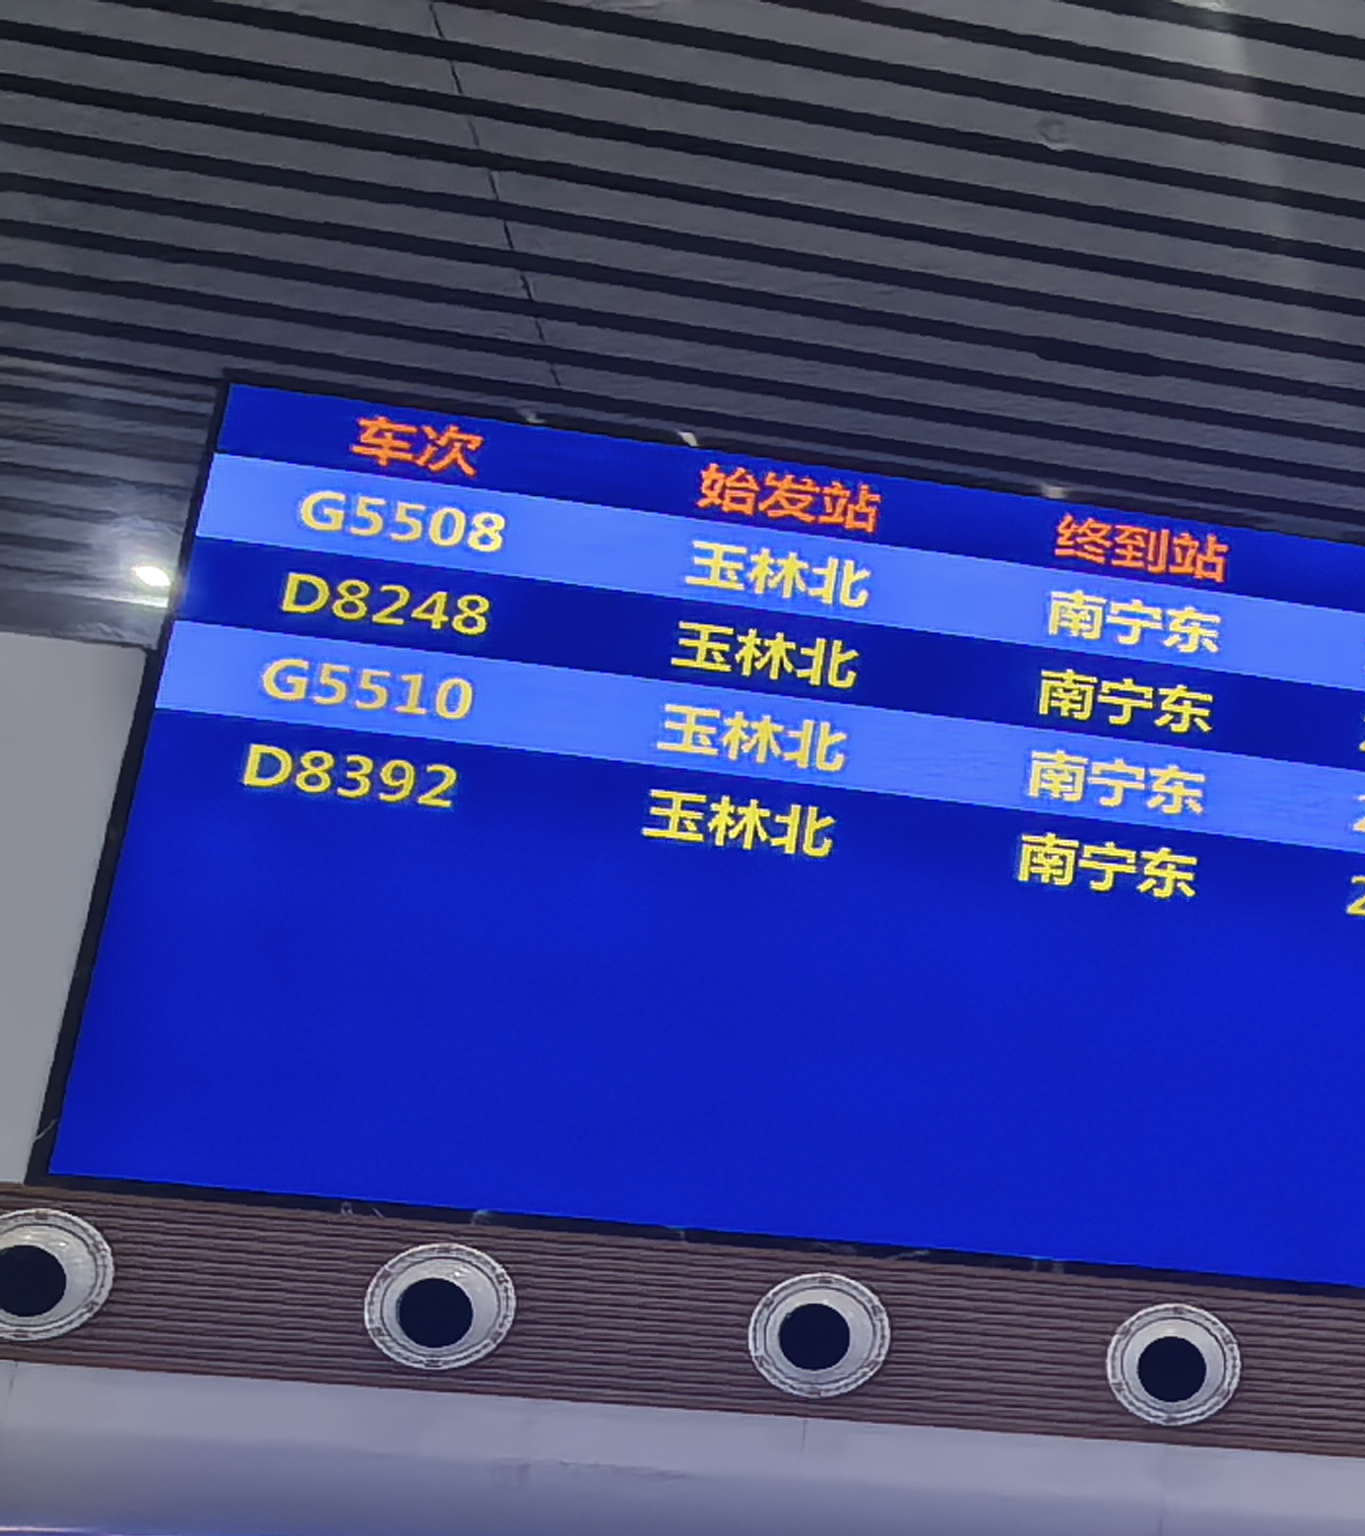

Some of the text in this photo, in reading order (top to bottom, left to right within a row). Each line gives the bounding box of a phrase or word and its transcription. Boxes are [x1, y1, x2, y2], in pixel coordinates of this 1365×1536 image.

[299, 491, 505, 552] G5508
[686, 540, 870, 608] 玉林北
[1048, 589, 1221, 653] 南宁东
[352, 416, 482, 476] 车次
[697, 463, 880, 532] 始发站
[1055, 514, 1228, 582] 终到站
[282, 573, 489, 634] D8248
[671, 622, 858, 687] 玉林北
[1039, 669, 1212, 732] 南宁东
[261, 659, 472, 719] G5510
[656, 704, 846, 771] 玉林北
[1027, 750, 1205, 814] 南宁东
[243, 744, 456, 807] D8392
[643, 790, 835, 856] 玉林北
[1018, 833, 1197, 898] 南宁东
